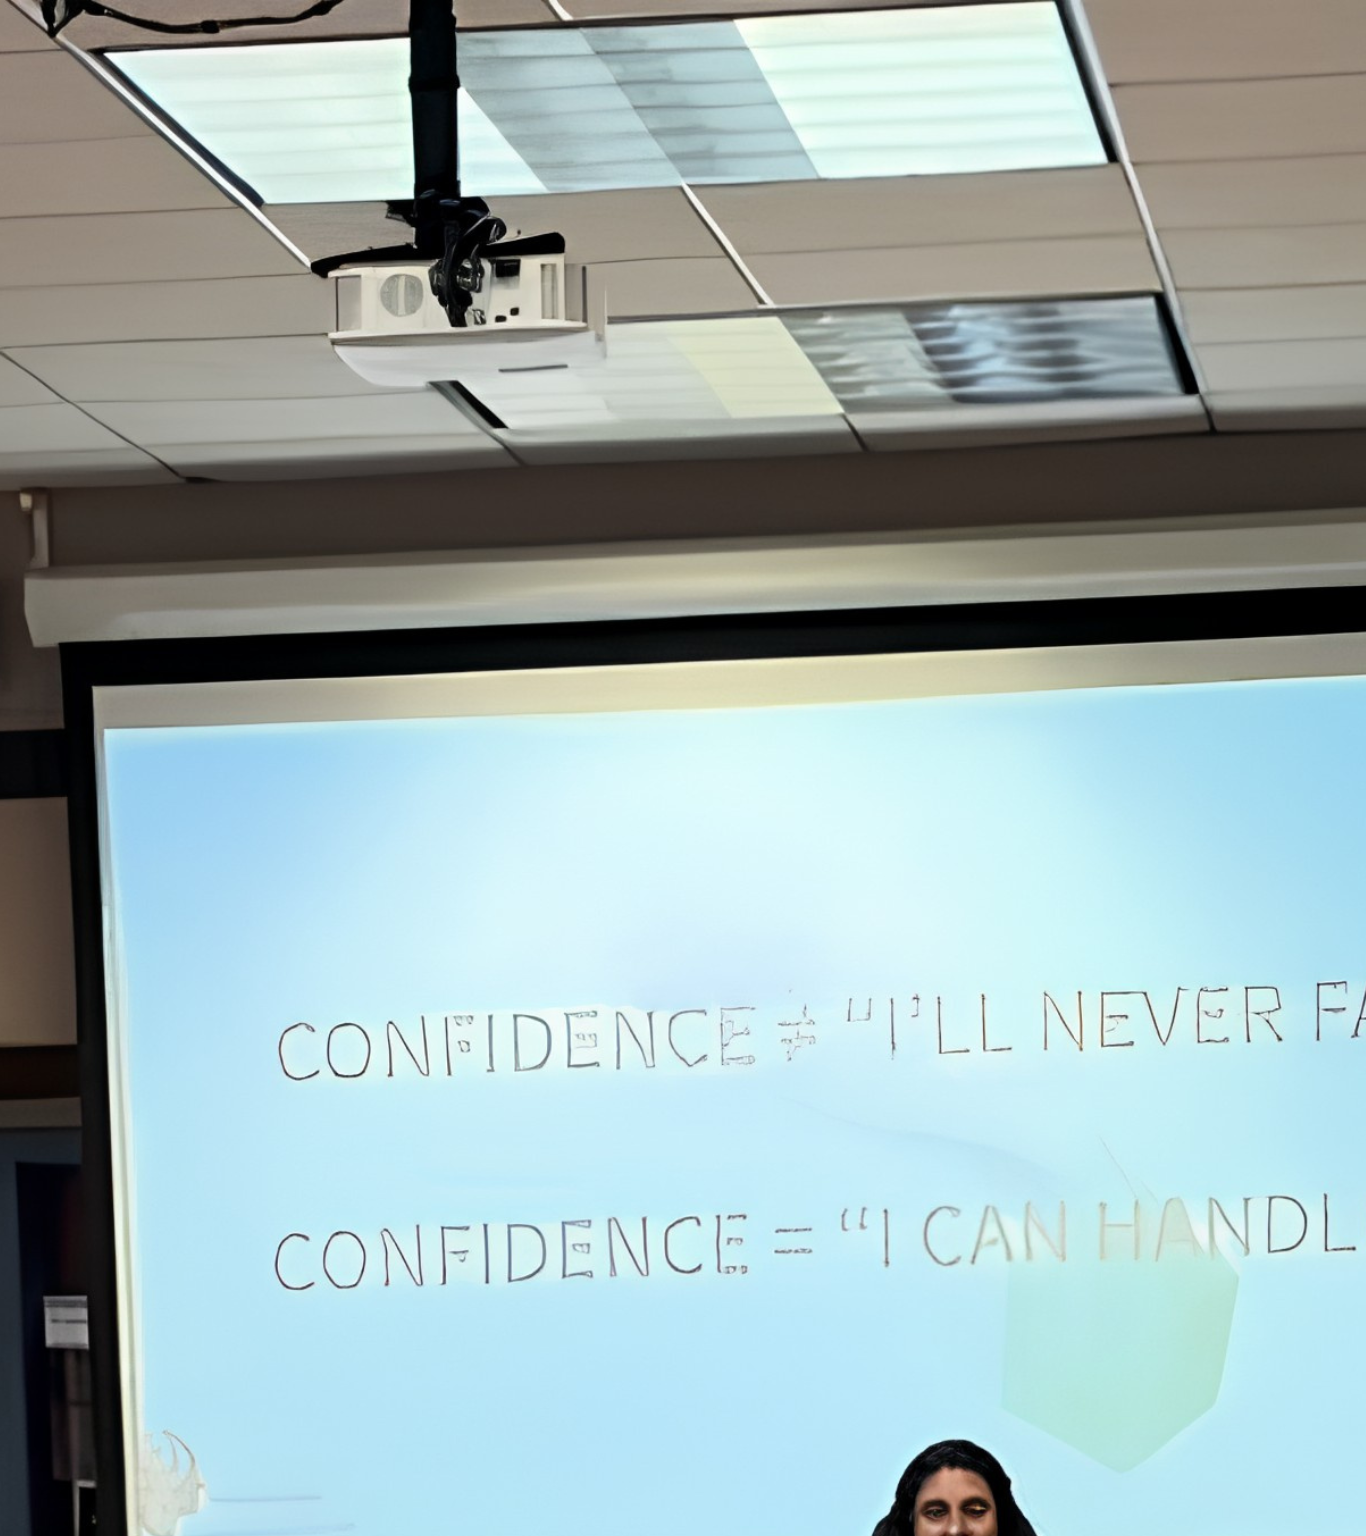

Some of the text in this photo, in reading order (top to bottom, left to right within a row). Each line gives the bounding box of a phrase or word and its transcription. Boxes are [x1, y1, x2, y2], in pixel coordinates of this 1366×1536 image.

[278, 1004, 756, 1081] CONFIDENCE
[1043, 985, 1283, 1051] NEVER
[275, 1213, 748, 1291] CONFIDENCE
[922, 1200, 1067, 1267] CAN
